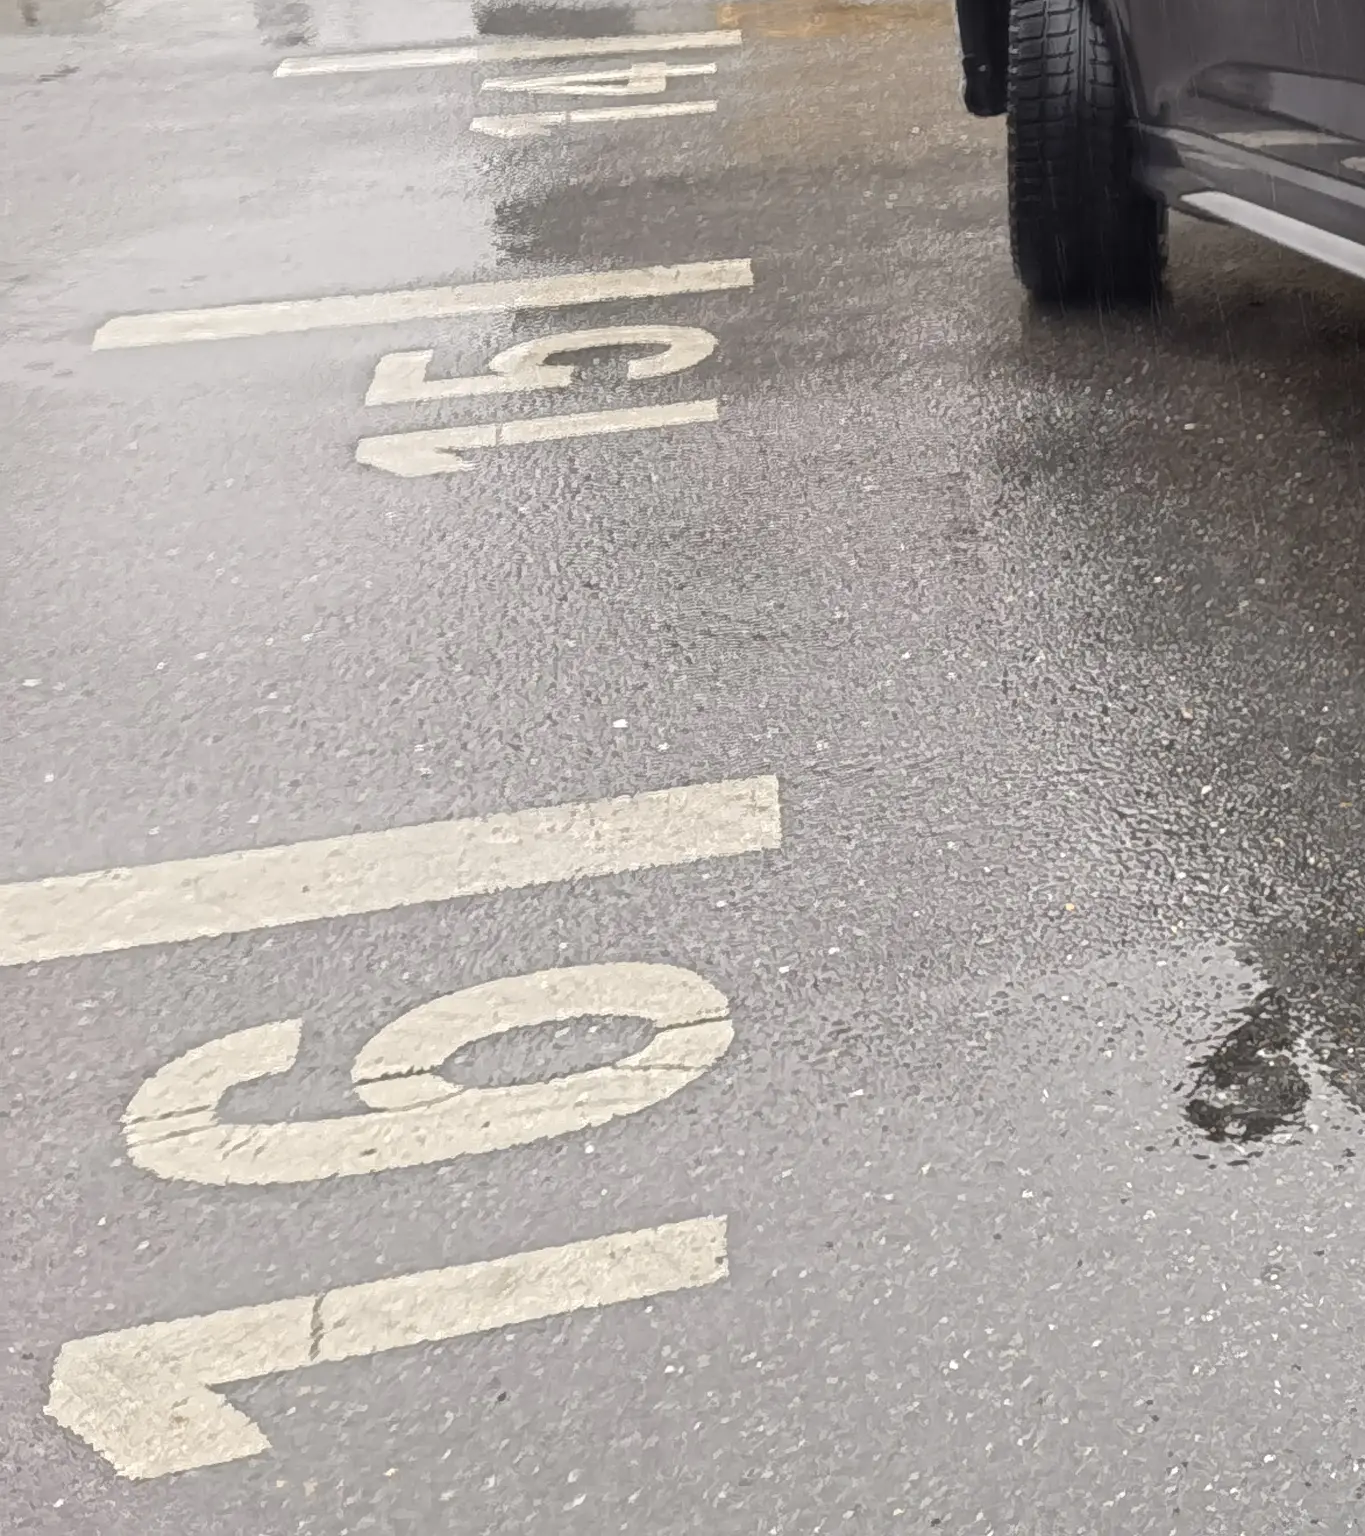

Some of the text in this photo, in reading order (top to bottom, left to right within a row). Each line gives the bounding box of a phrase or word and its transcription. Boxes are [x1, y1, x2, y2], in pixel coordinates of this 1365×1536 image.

[469, 61, 718, 137] 14
[356, 325, 720, 478] 15
[43, 962, 735, 1481] 16
